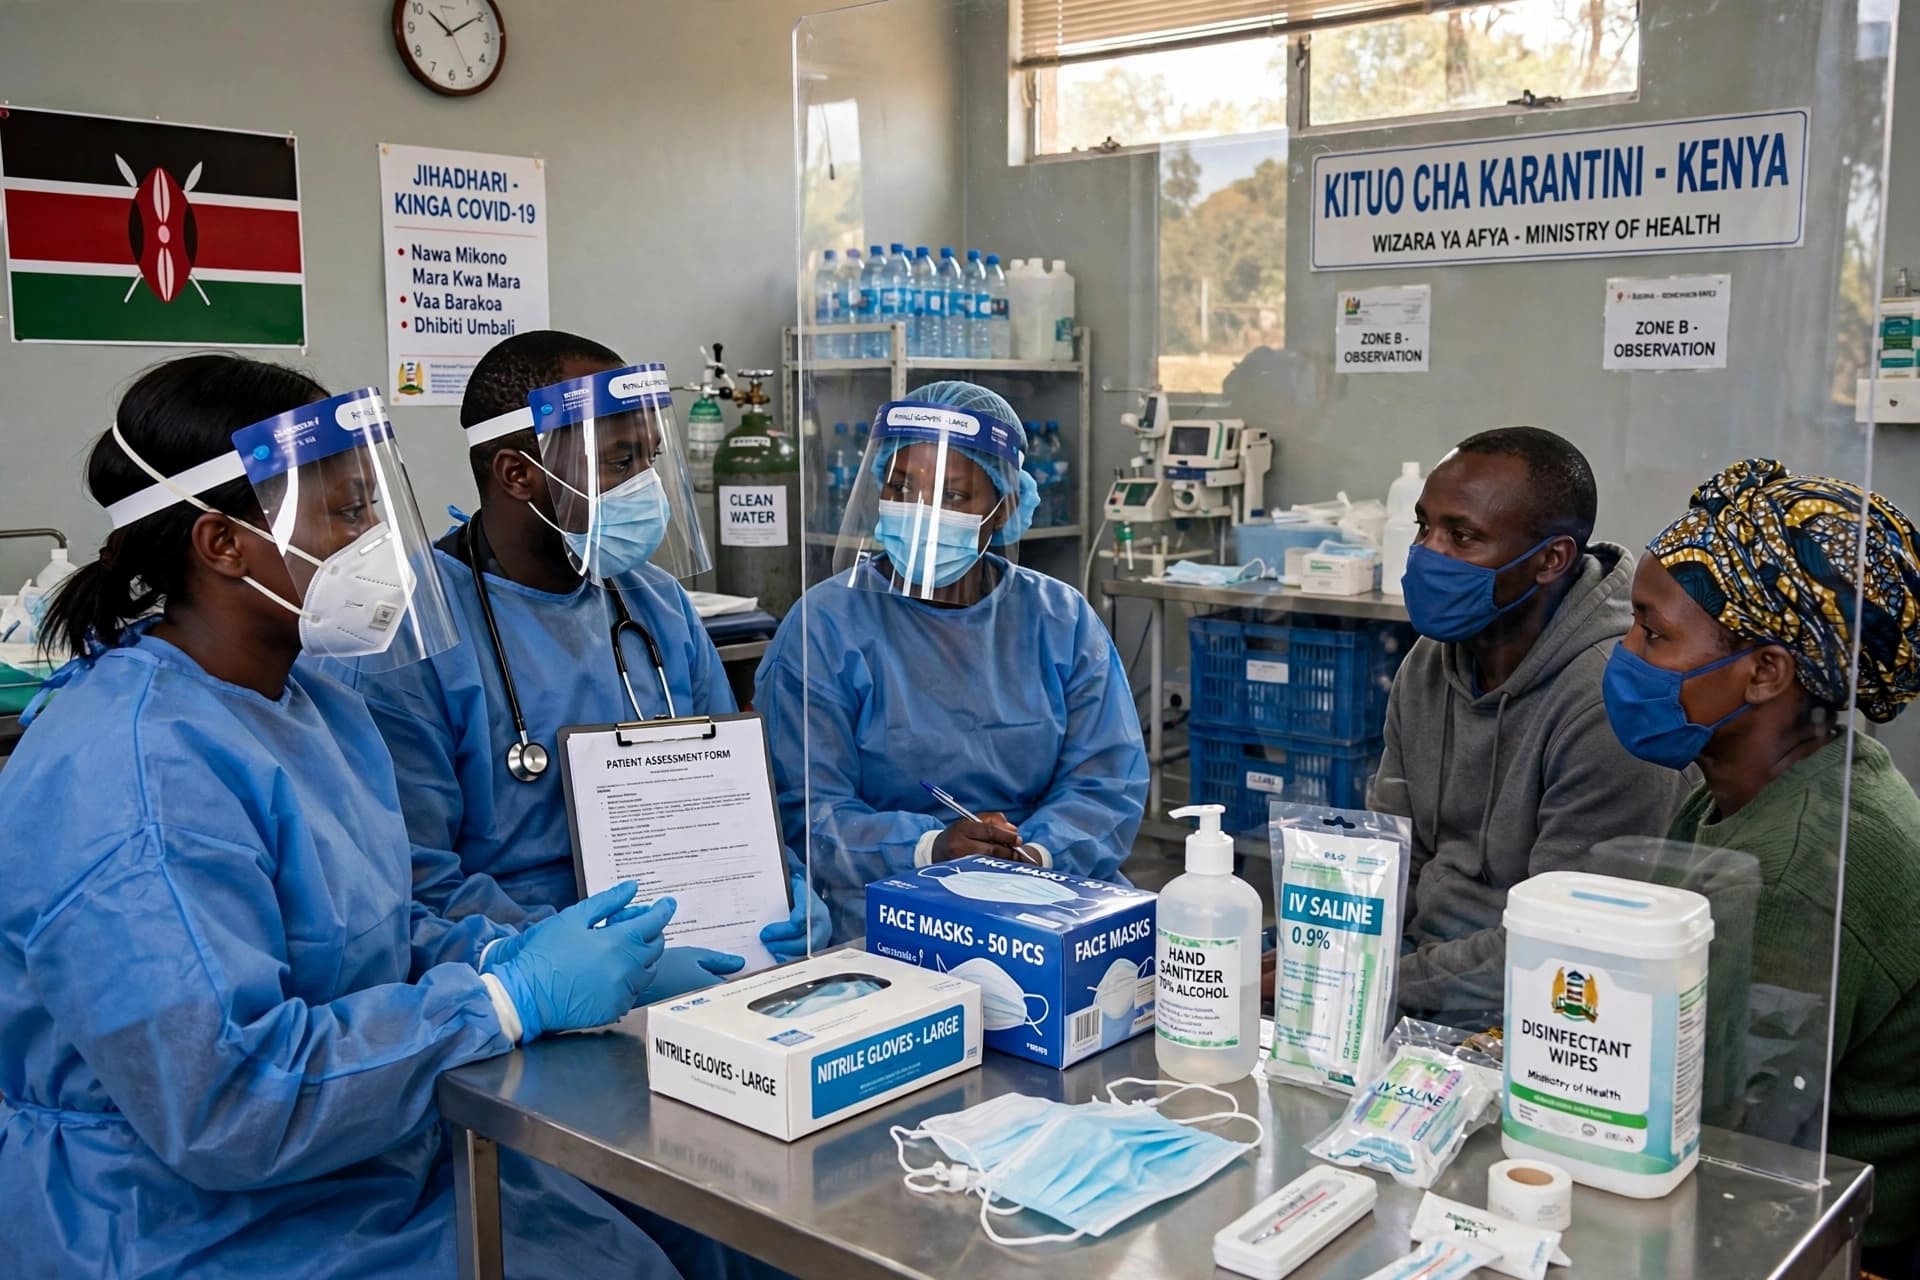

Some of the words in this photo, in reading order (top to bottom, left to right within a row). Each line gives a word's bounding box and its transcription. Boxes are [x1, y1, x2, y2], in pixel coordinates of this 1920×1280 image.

[412, 2, 424, 15] 10
[408, 22, 416, 33] 9
[484, 32, 490, 44] 3
[414, 45, 422, 57] 8
[479, 53, 486, 64] 4
[430, 61, 437, 72] 7
[448, 70, 456, 81] 6
[466, 66, 474, 78] 5
[413, 164, 507, 192] JIHADHARI
[1324, 167, 1404, 218] KITUO
[1413, 161, 1470, 212] CHA
[1480, 146, 1644, 208] KARANTINI
[1656, 168, 1666, 179] -
[1677, 132, 1789, 193] KENYA
[394, 192, 452, 218] KINGA
[457, 198, 536, 224] COVID-19
[1372, 232, 1436, 252] WIZARA
[1440, 230, 1462, 249] YA
[1466, 228, 1509, 248] AFYA
[1526, 220, 1610, 244] MINISTRY
[1615, 218, 1640, 240] OF
[1646, 214, 1720, 237] HEALTH
[412, 244, 451, 262] Nawa
[456, 246, 507, 264] Mikono
[413, 268, 448, 286] Mara
[453, 270, 482, 287] Kwa
[488, 272, 520, 289] Mara
[413, 292, 440, 309] Vaa
[445, 293, 502, 311] Barakoa
[415, 316, 462, 334] Dhibiti
[467, 318, 515, 336] Umbali
[1635, 321, 1674, 335] ZONE
[1679, 320, 1688, 334] B
[1360, 332, 1391, 345] ZONE
[1394, 332, 1402, 344] B
[1344, 350, 1422, 363] OBSERVATION
[1614, 342, 1715, 358] OBSERVATION
[730, 494, 773, 506] CLEAN
[730, 511, 775, 524] WATER
[606, 758, 642, 769] PATIENT
[645, 752, 703, 766] ASSESSMENT
[704, 750, 732, 760] FORM
[1289, 892, 1307, 912] IV
[1309, 896, 1373, 925] SALINE
[879, 904, 915, 931] FACE
[919, 915, 974, 947] MASKS
[988, 933, 1007, 956] 50
[1012, 939, 1045, 966] PCS
[1074, 934, 1106, 962] FACE
[1109, 918, 1150, 950] MASKS
[1292, 926, 1330, 950] 0.9%
[1169, 946, 1205, 966] HAND
[1160, 960, 1223, 983] SANITIZER
[1159, 976, 1174, 992] 70%
[1176, 984, 1229, 999] ALCOHOL
[1522, 1019, 1631, 1059] DISINFECTANT
[818, 1050, 864, 1085] NITRILE
[867, 1032, 913, 1069] GLOVES
[923, 1015, 959, 1044] LARGE
[1549, 1046, 1598, 1072] WIPES
[655, 1037, 691, 1065] NITRILE
[693, 1052, 733, 1080] GLOVES
[741, 1068, 776, 1096] LARGE
[1378, 1082, 1396, 1092] IV
[1396, 1086, 1445, 1106] SALINE
[1573, 1083, 1583, 1091] of
[1586, 1085, 1621, 1100] Health
